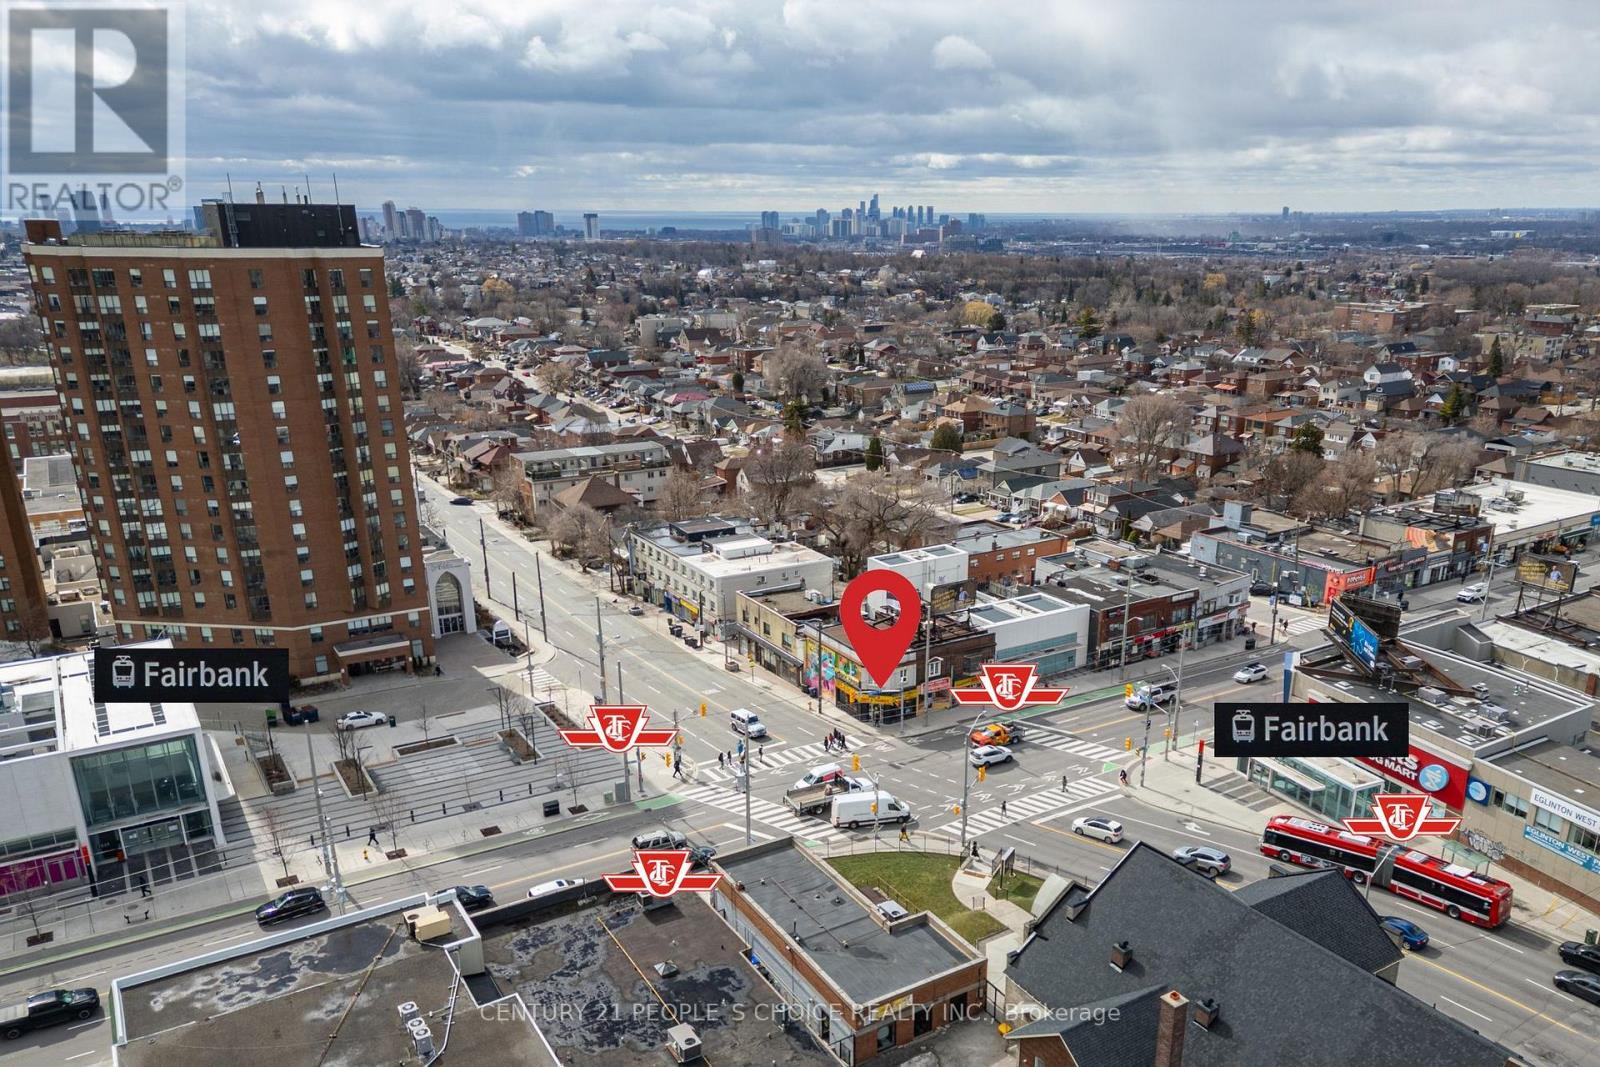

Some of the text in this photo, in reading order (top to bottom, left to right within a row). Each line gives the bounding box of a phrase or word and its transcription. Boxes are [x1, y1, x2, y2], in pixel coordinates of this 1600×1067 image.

[1384, 759, 1418, 781] MART
[1534, 794, 1598, 828] EGLINTON WEST
[1526, 825, 1565, 849] EGLINTON
[1567, 845, 1593, 861] WEST
